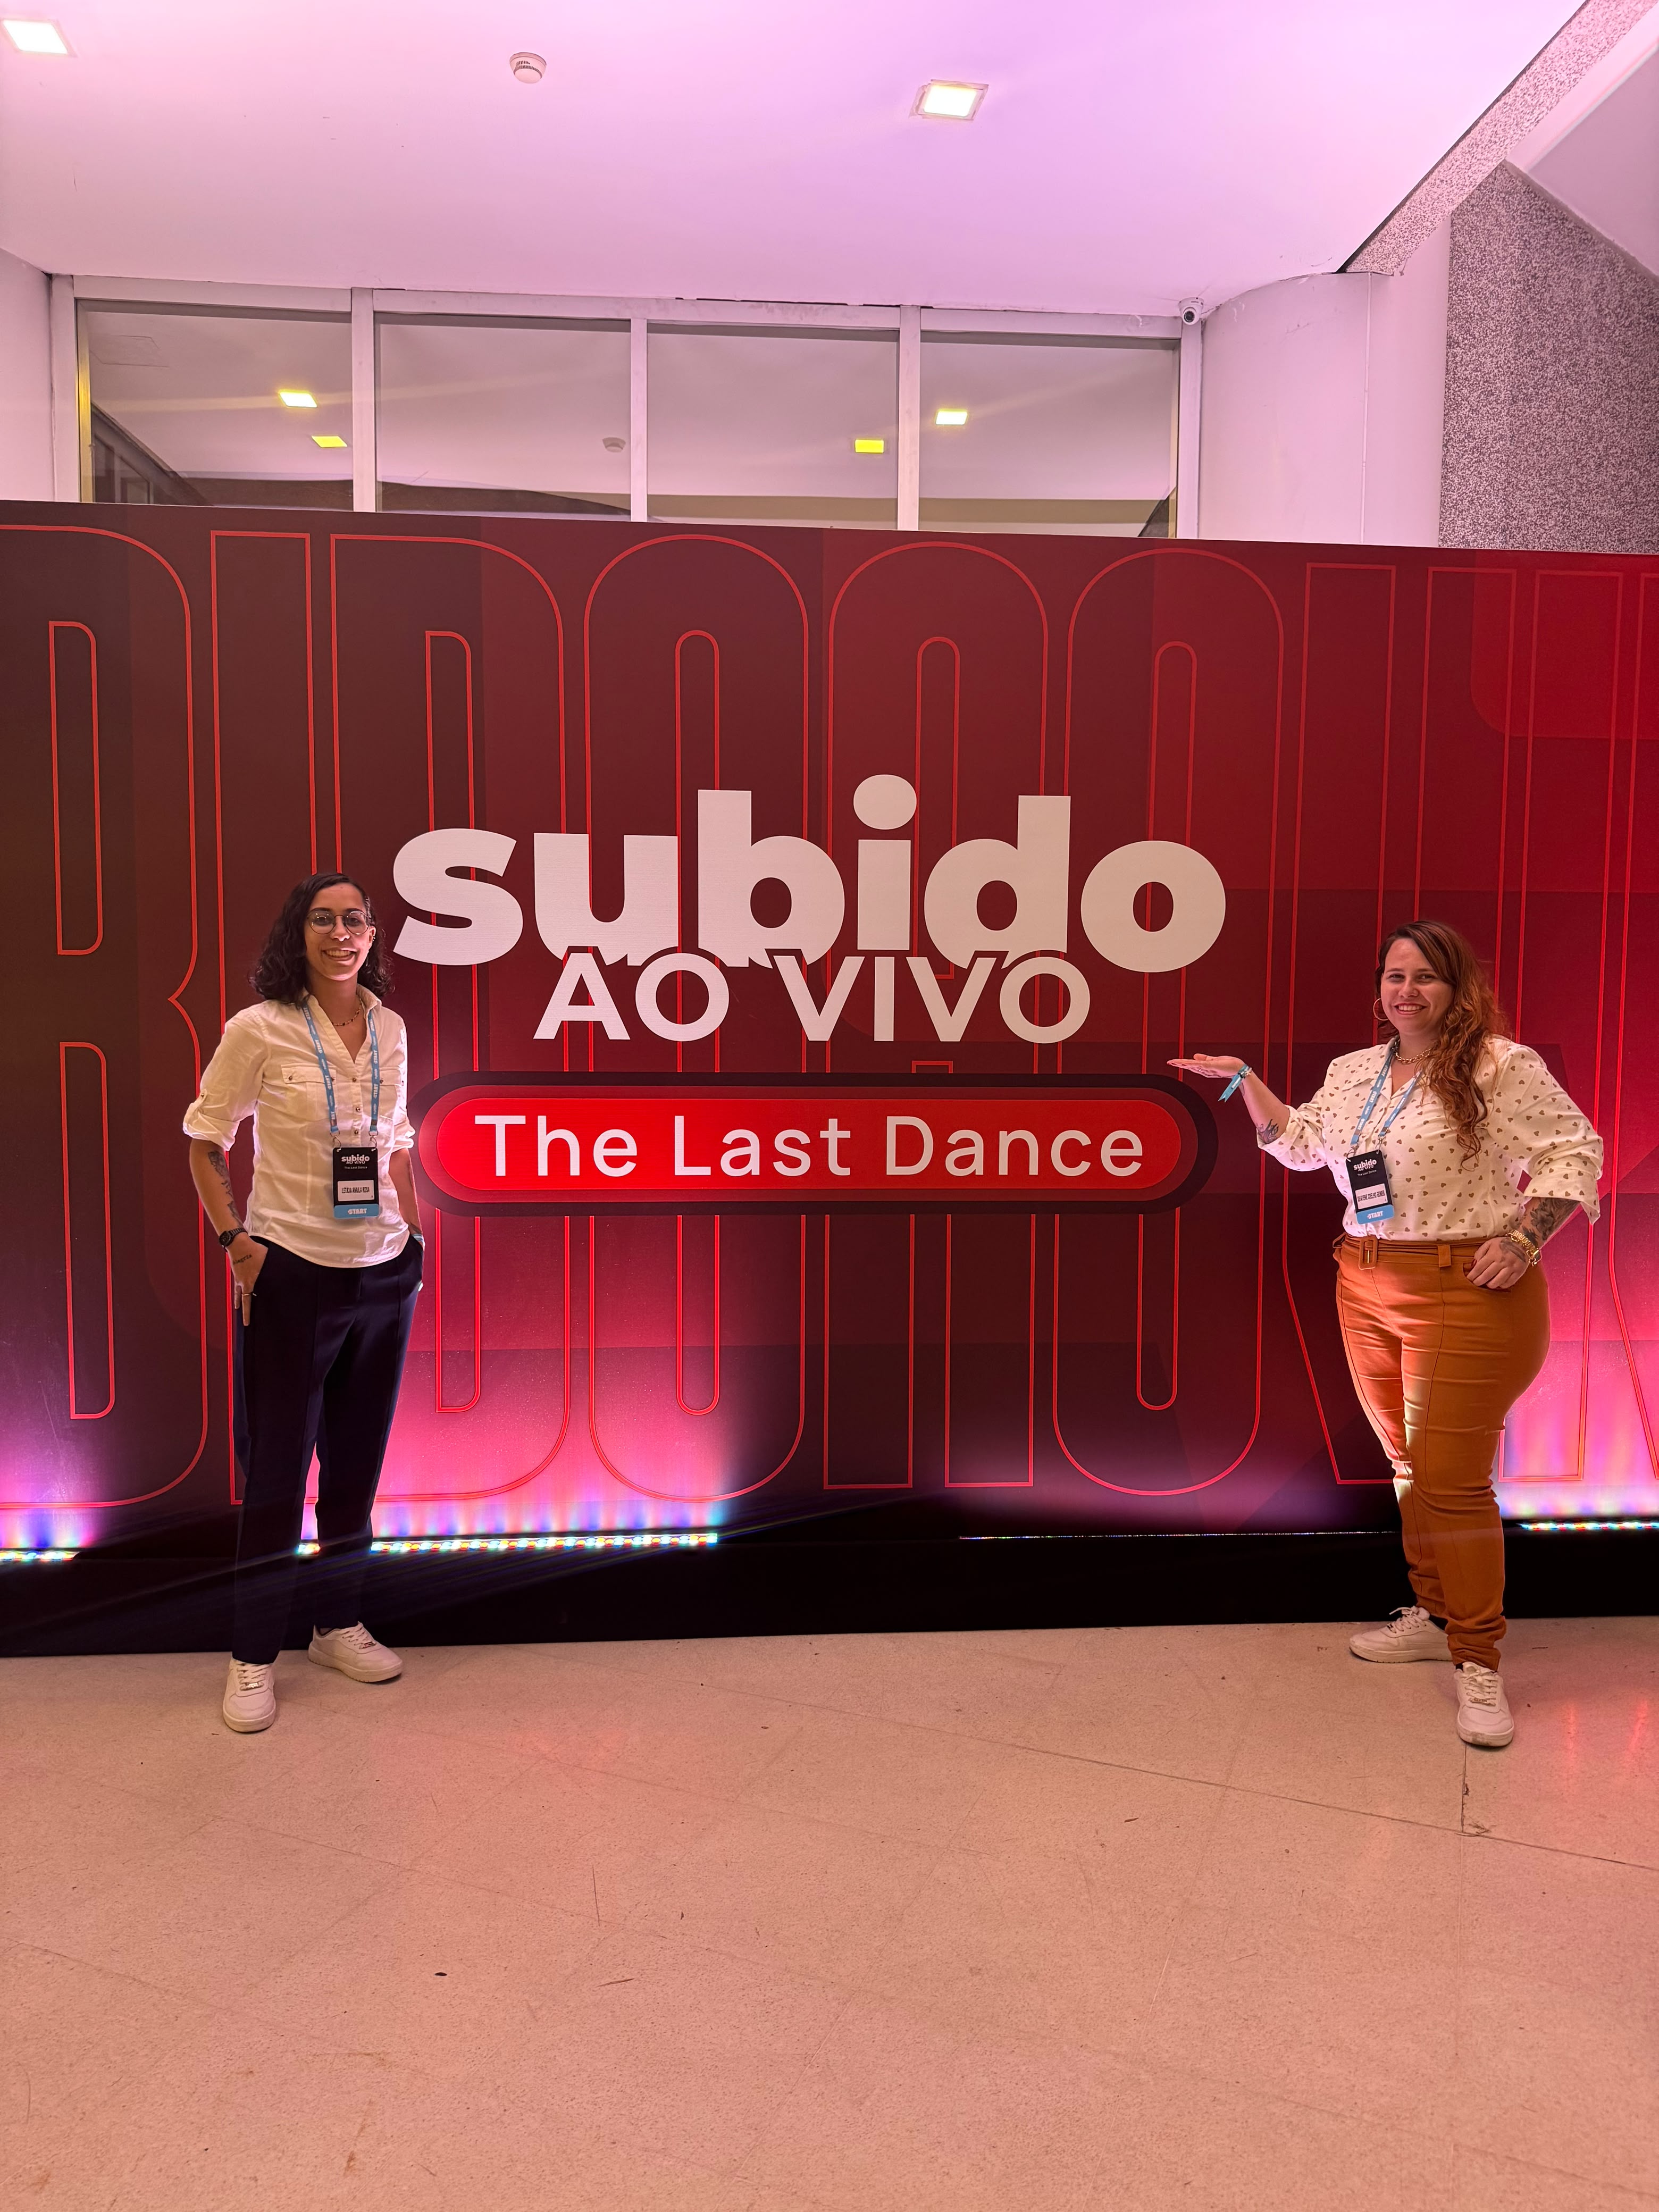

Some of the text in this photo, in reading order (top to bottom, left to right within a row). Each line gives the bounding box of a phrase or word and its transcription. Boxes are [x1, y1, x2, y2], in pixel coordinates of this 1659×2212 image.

[393, 775, 1226, 972] subido
[533, 953, 1090, 1043] AO VIVO
[475, 1116, 1143, 1177] The Last Dance
[1353, 1159, 1377, 1170] subido
